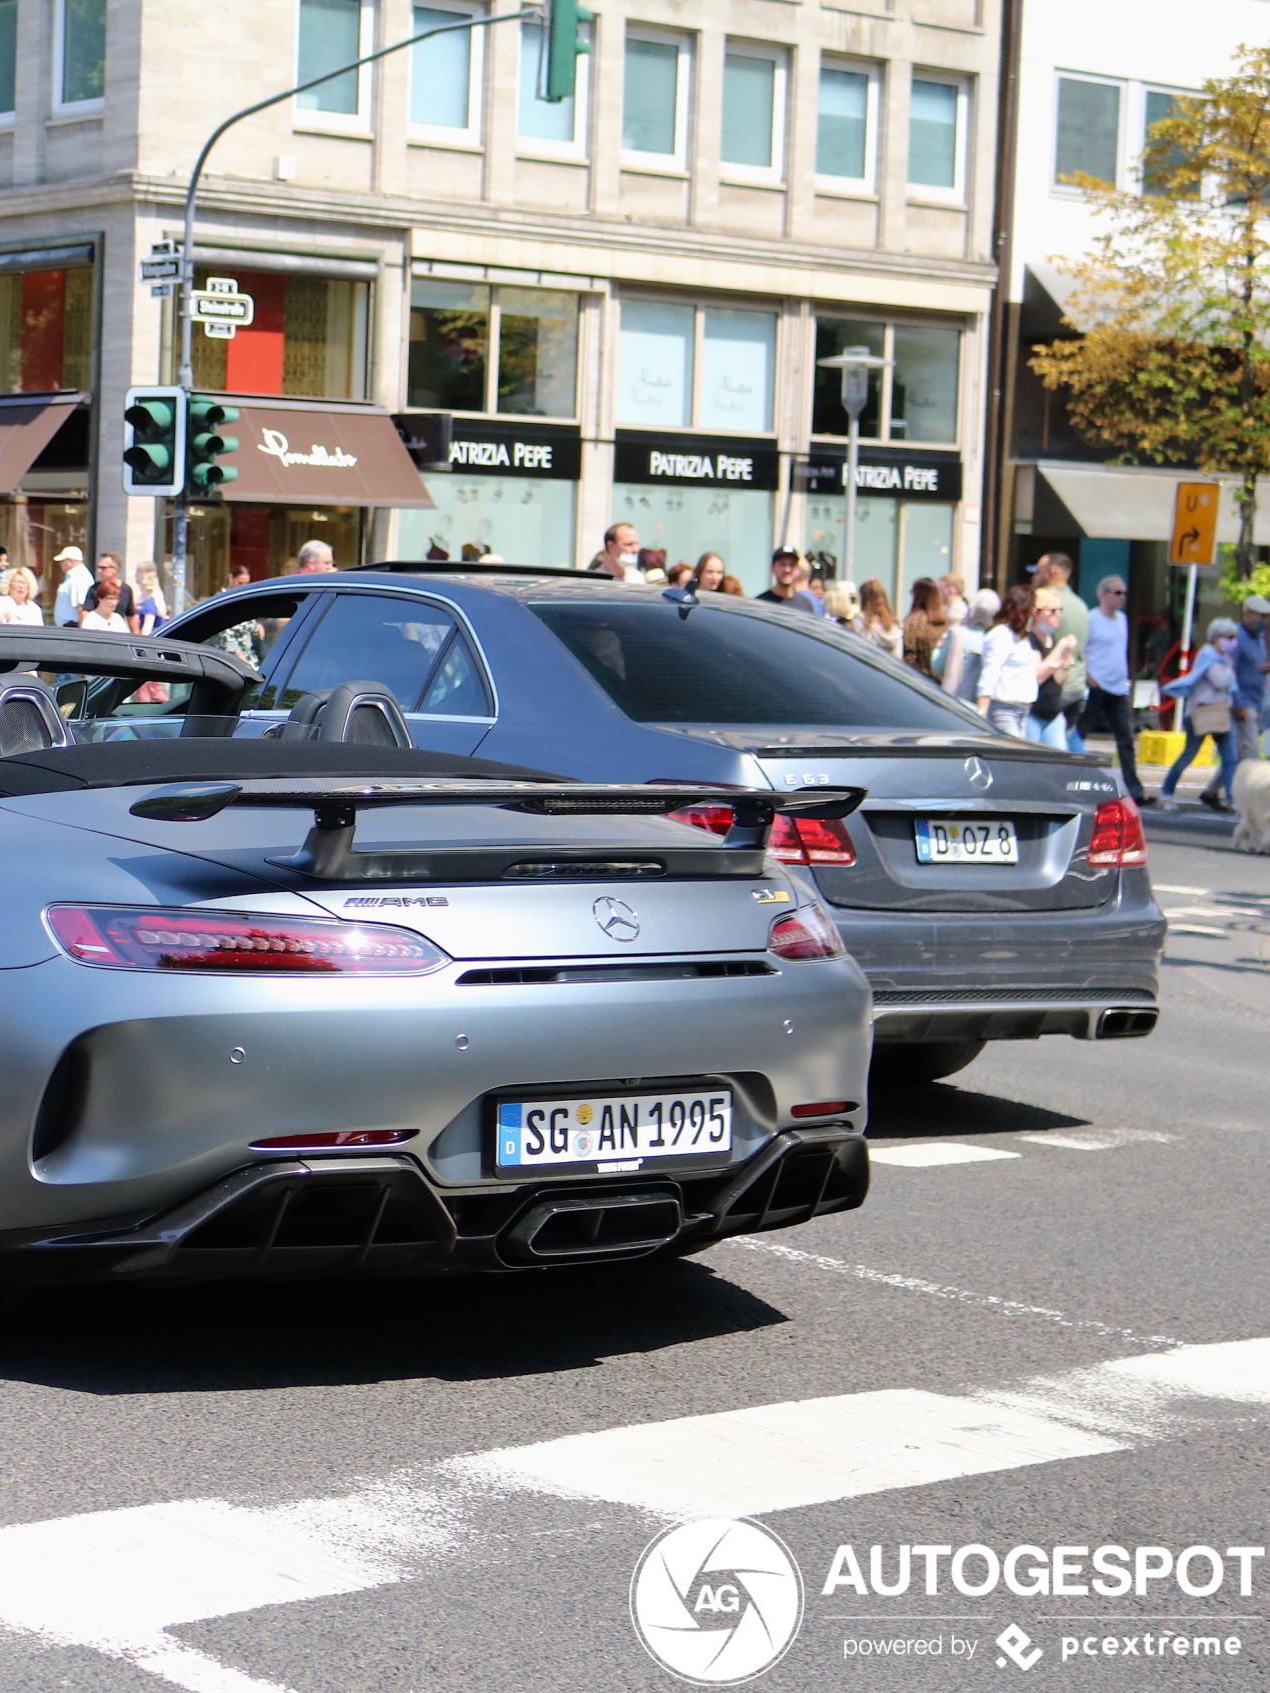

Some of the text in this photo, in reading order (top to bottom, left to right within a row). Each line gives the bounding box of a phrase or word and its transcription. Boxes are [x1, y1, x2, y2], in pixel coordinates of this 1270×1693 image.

[448, 440, 553, 469] ATRIZIA PEPE
[649, 450, 753, 481] PATRIZIA PEPE
[903, 465, 939, 492] PEPE
[802, 773, 830, 785] 63
[998, 826, 1011, 855] 8
[377, 896, 450, 908] AMG
[526, 1098, 725, 1156] SG AN 1995
